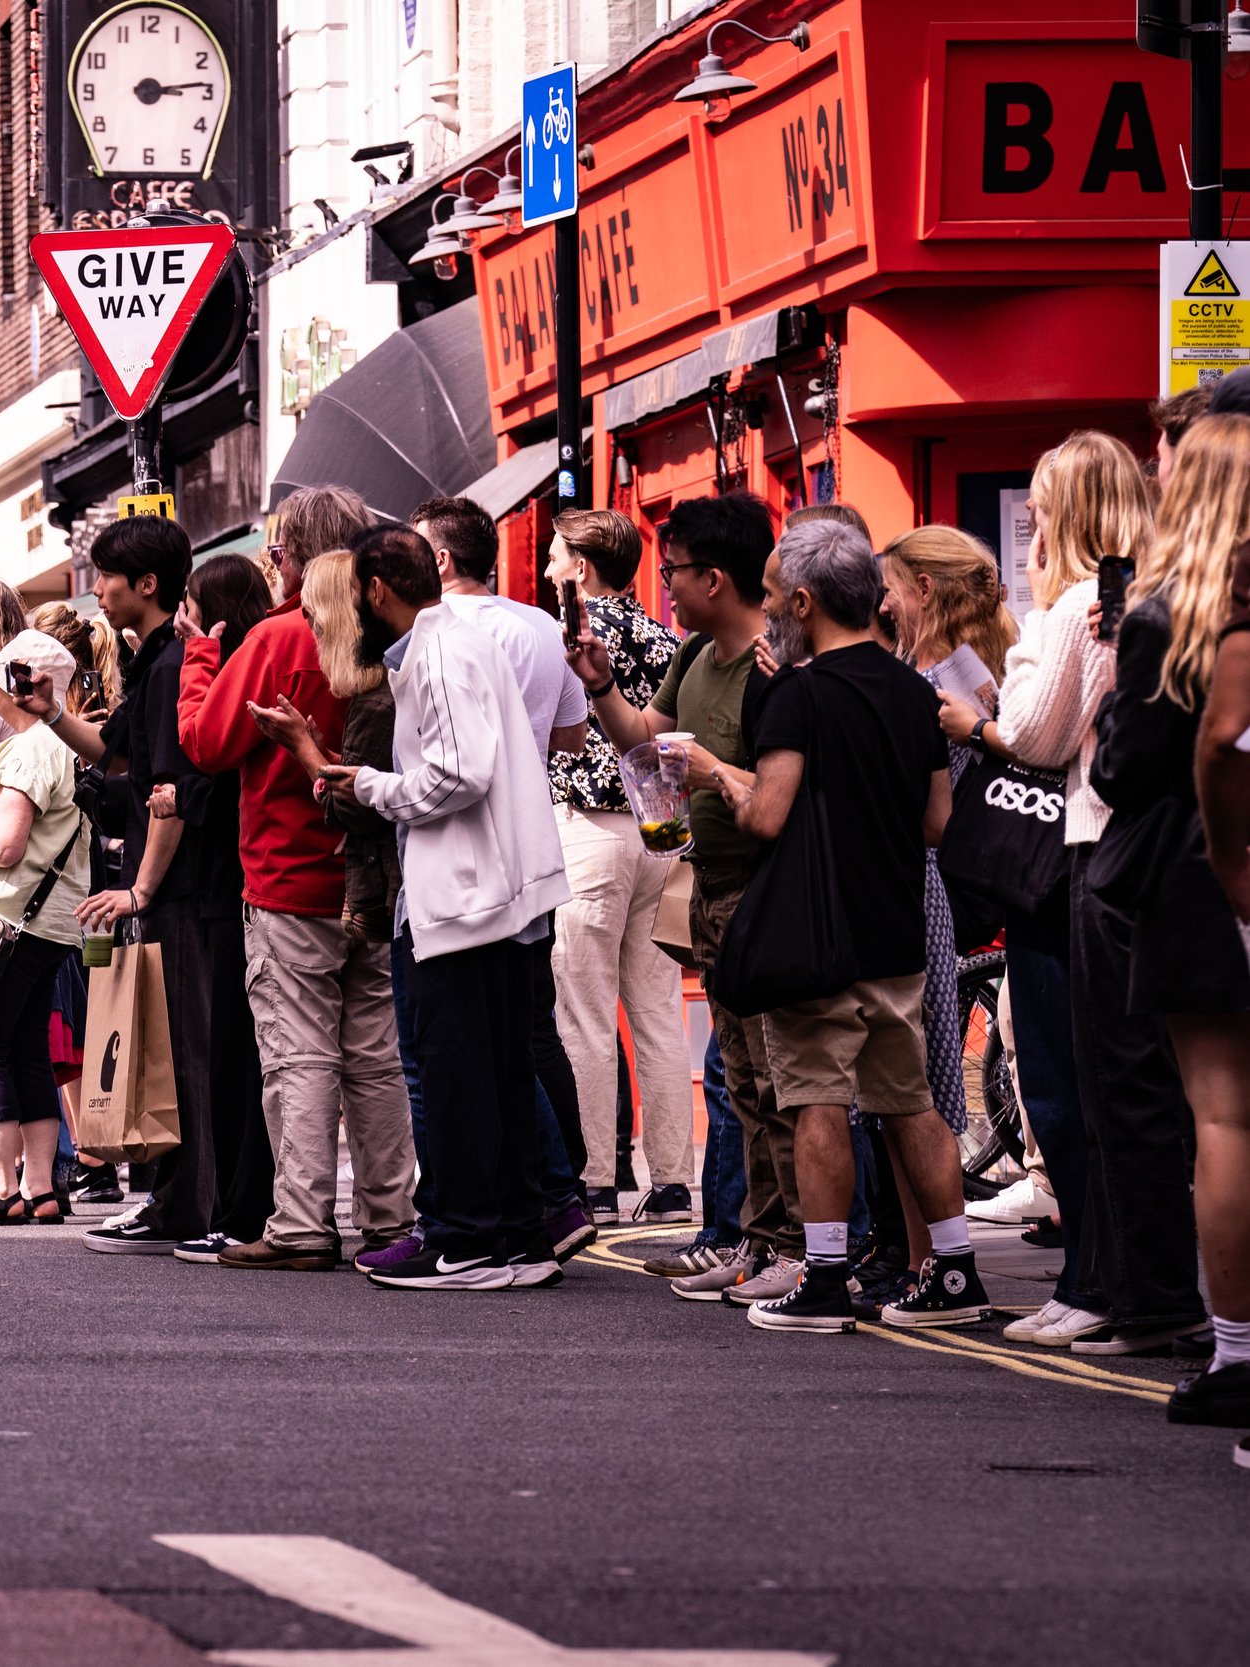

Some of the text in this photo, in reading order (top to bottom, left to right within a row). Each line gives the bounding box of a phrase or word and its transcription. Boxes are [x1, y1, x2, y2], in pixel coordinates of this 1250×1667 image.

[141, 16, 160, 34] 12
[118, 26, 129, 43] 11
[175, 26, 180, 44] 1
[87, 52, 106, 70] 10
[196, 52, 208, 70] 2
[84, 84, 94, 101] 9
[202, 84, 214, 100] 3
[92, 116, 106, 132] 8
[194, 117, 207, 133] 4
[105, 146, 118, 164] 7
[143, 148, 154, 165] 6
[181, 149, 190, 166] 5
[110, 180, 195, 209] CAFFE
[78, 250, 184, 288] GIVE
[98, 294, 166, 320] WAY
[1188, 304, 1234, 316] CCTV
[985, 777, 1064, 822] asos
